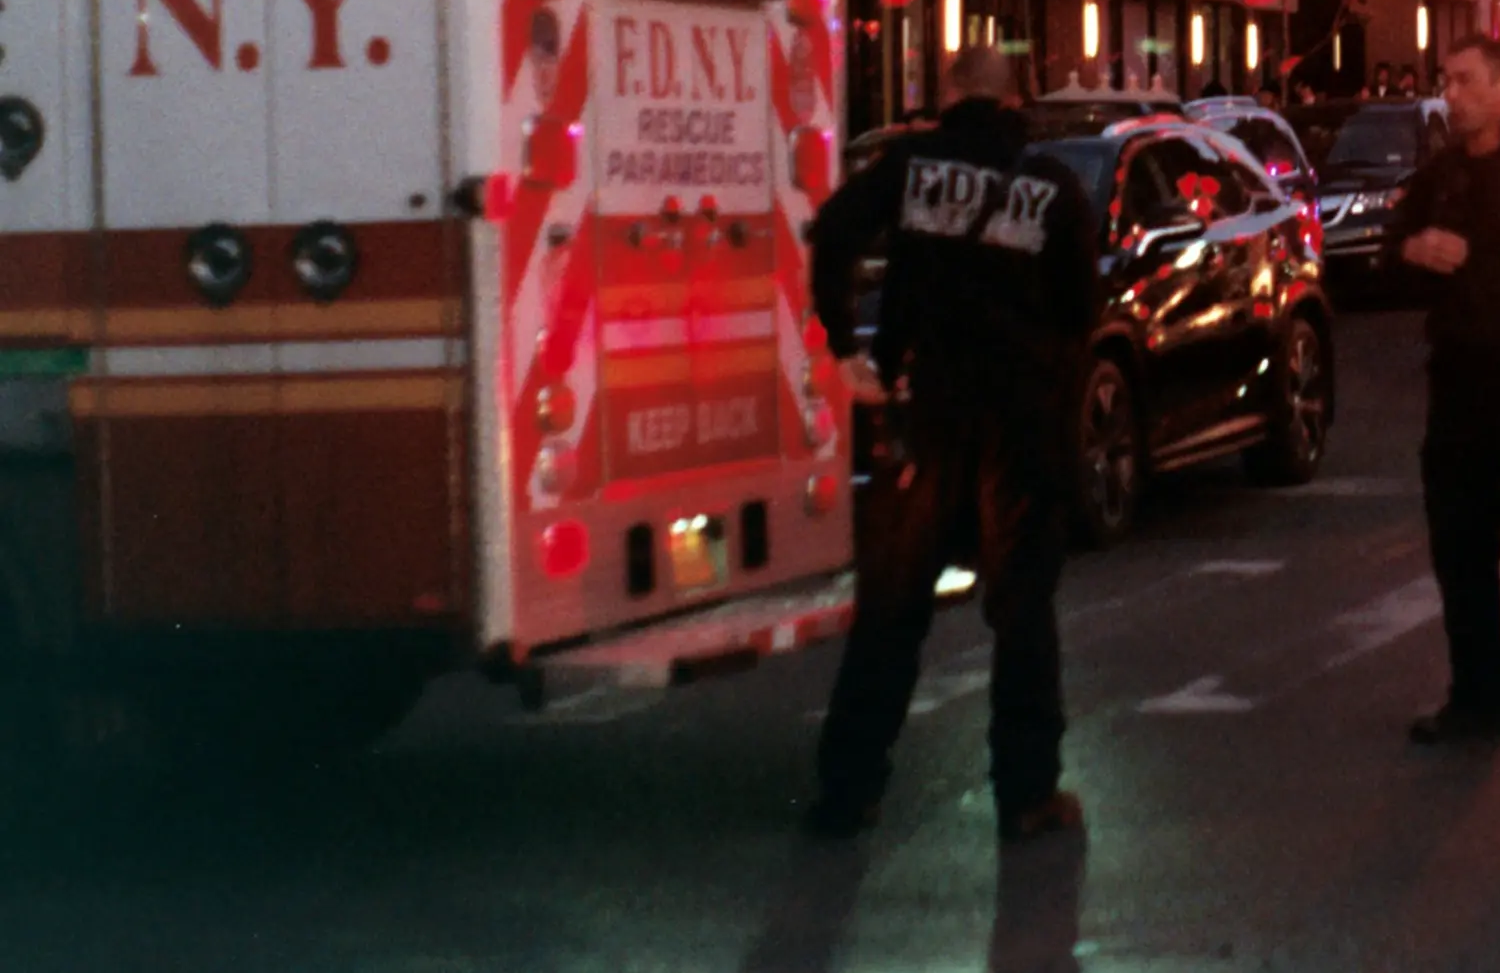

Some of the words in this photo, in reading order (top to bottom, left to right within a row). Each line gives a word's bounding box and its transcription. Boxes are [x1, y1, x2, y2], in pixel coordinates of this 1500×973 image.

[614, 16, 756, 102] F.D.N.Y.
[638, 108, 735, 144] RESCUE
[606, 150, 765, 185] PARAMEDICS
[628, 402, 690, 454] KEEP
[696, 395, 759, 444] BACK
